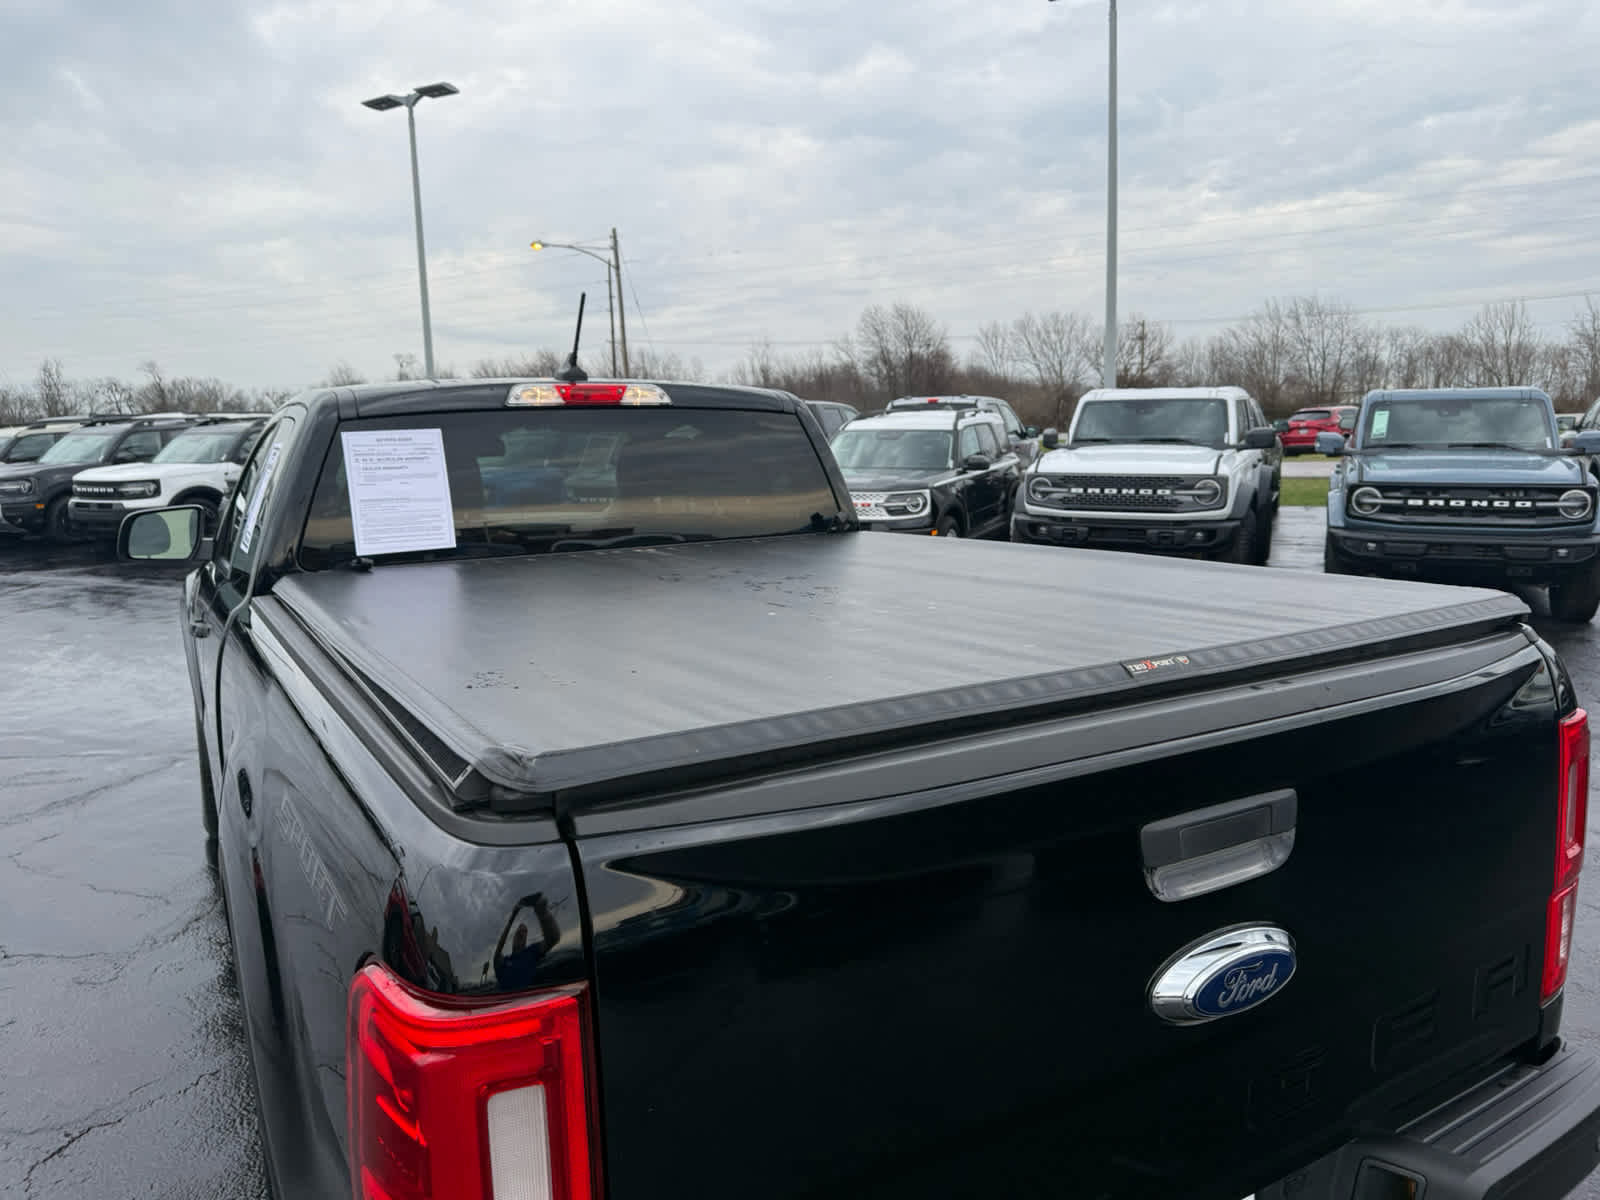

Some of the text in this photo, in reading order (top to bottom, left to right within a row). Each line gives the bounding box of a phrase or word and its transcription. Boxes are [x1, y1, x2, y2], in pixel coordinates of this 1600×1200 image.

[1070, 487, 1171, 495] BRONCO
[1407, 499, 1532, 508] BRONCO
[1217, 960, 1279, 1008] Ford
